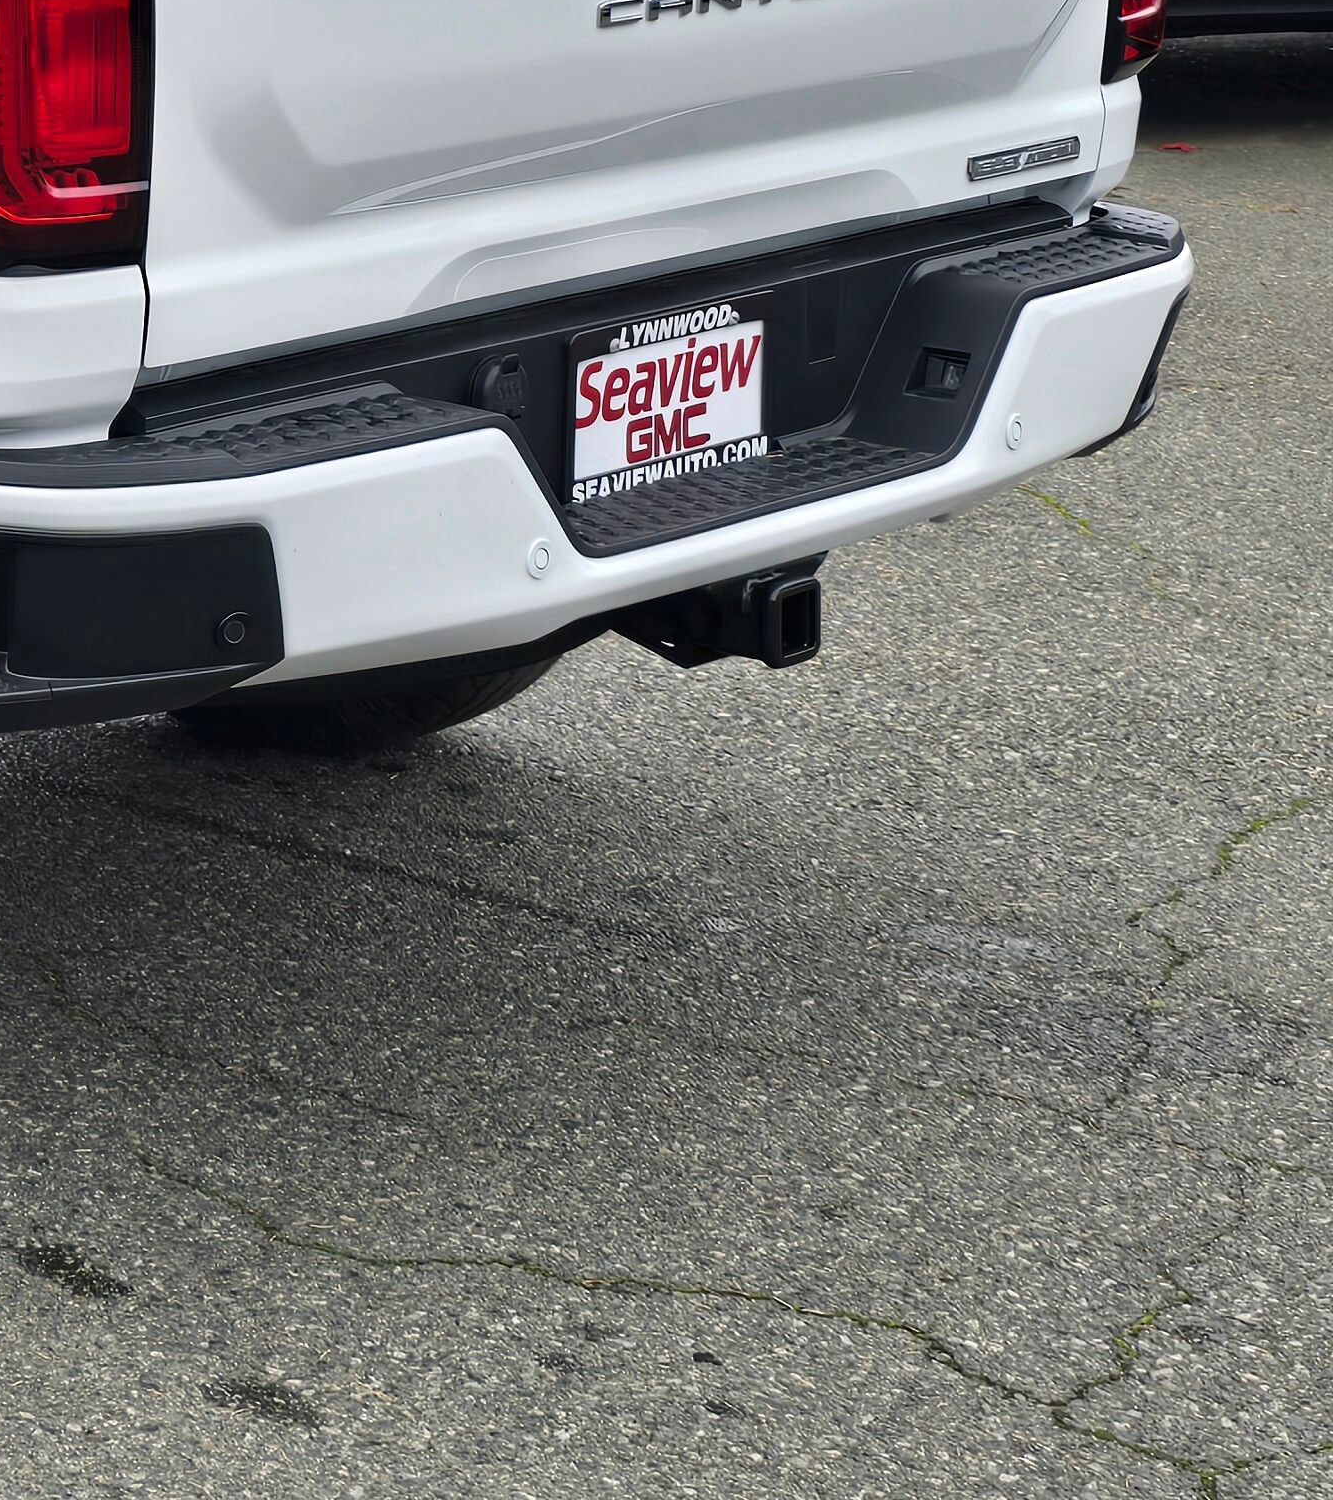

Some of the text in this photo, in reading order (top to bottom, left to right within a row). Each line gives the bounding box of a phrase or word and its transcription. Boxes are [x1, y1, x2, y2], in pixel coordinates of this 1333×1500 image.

[619, 304, 732, 350] LYNNWOOD
[574, 335, 763, 430] Seaview
[626, 402, 711, 465] GMC
[571, 436, 768, 504] SEAVIEWAUTO.COM
